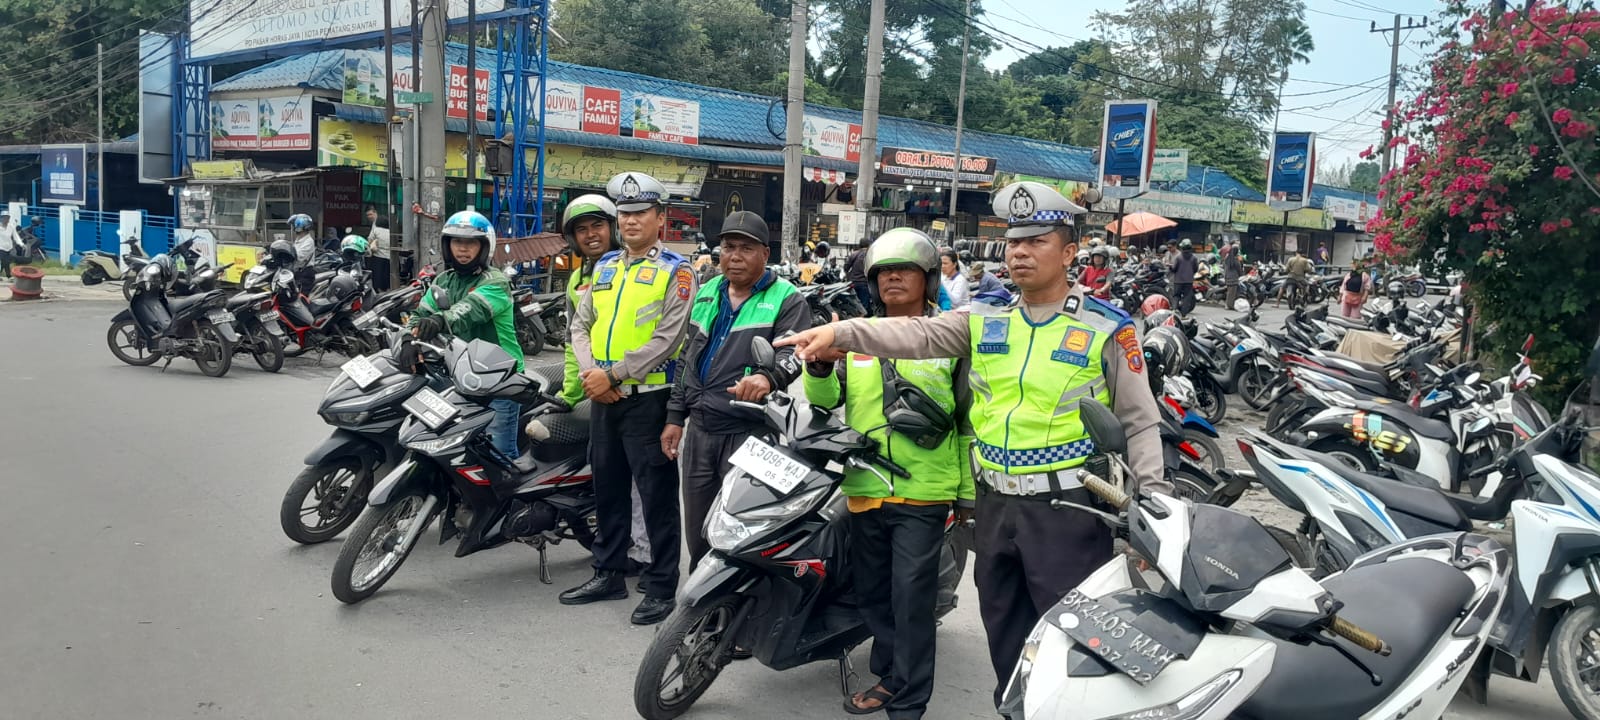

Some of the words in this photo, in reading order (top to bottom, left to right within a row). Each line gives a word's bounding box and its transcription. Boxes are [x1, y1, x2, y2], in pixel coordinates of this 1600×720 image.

[252, 13, 307, 34] SUTOMO
[313, 3, 371, 25] SQUARE
[287, 31, 301, 42] JAYA
[304, 29, 319, 39] KOTA
[351, 20, 377, 32] SIANTAR
[451, 73, 487, 91] BOM
[449, 88, 487, 102] BURER
[447, 100, 455, 109] &
[457, 101, 488, 113] KEAB
[545, 93, 578, 112] QUVIVA
[585, 97, 618, 114] CAFE
[584, 112, 618, 126] FAMILY
[648, 131, 669, 141] FAMILY
[670, 134, 684, 143] CAFE
[821, 130, 845, 145] AQUVIVA
[1113, 128, 1136, 141] CHIEF
[930, 155, 960, 169] POTON
[1280, 154, 1300, 165] CHIEF
[334, 193, 349, 201] PAK
[325, 201, 360, 210] TANJUNG
[756, 446, 786, 468] 5096
[784, 461, 807, 480] WAJ
[1081, 604, 1132, 639] 4405
